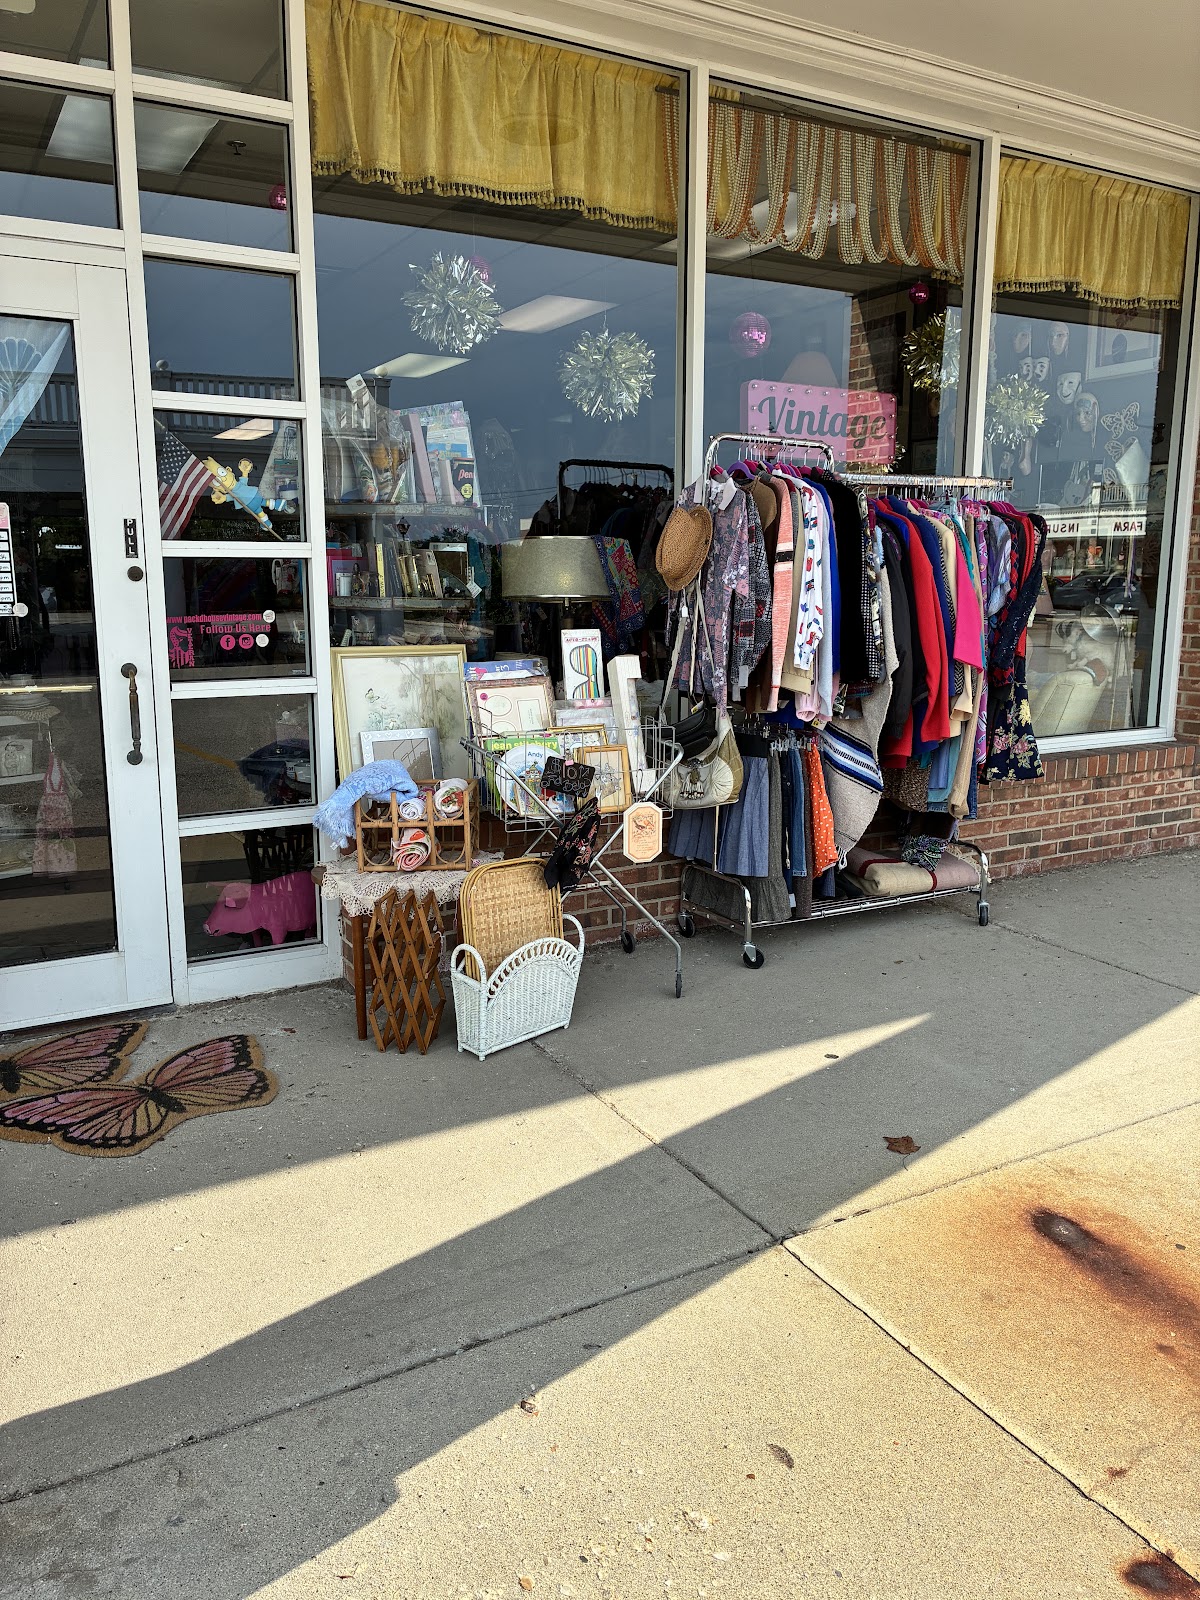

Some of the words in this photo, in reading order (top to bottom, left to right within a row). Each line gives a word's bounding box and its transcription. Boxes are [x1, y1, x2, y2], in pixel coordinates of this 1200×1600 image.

[757, 396, 887, 449] Vintage
[127, 518, 135, 554] PULL
[200, 624, 233, 635] Follow
[235, 623, 247, 633] Us
[249, 623, 271, 632] Here
[491, 741, 512, 751] jean
